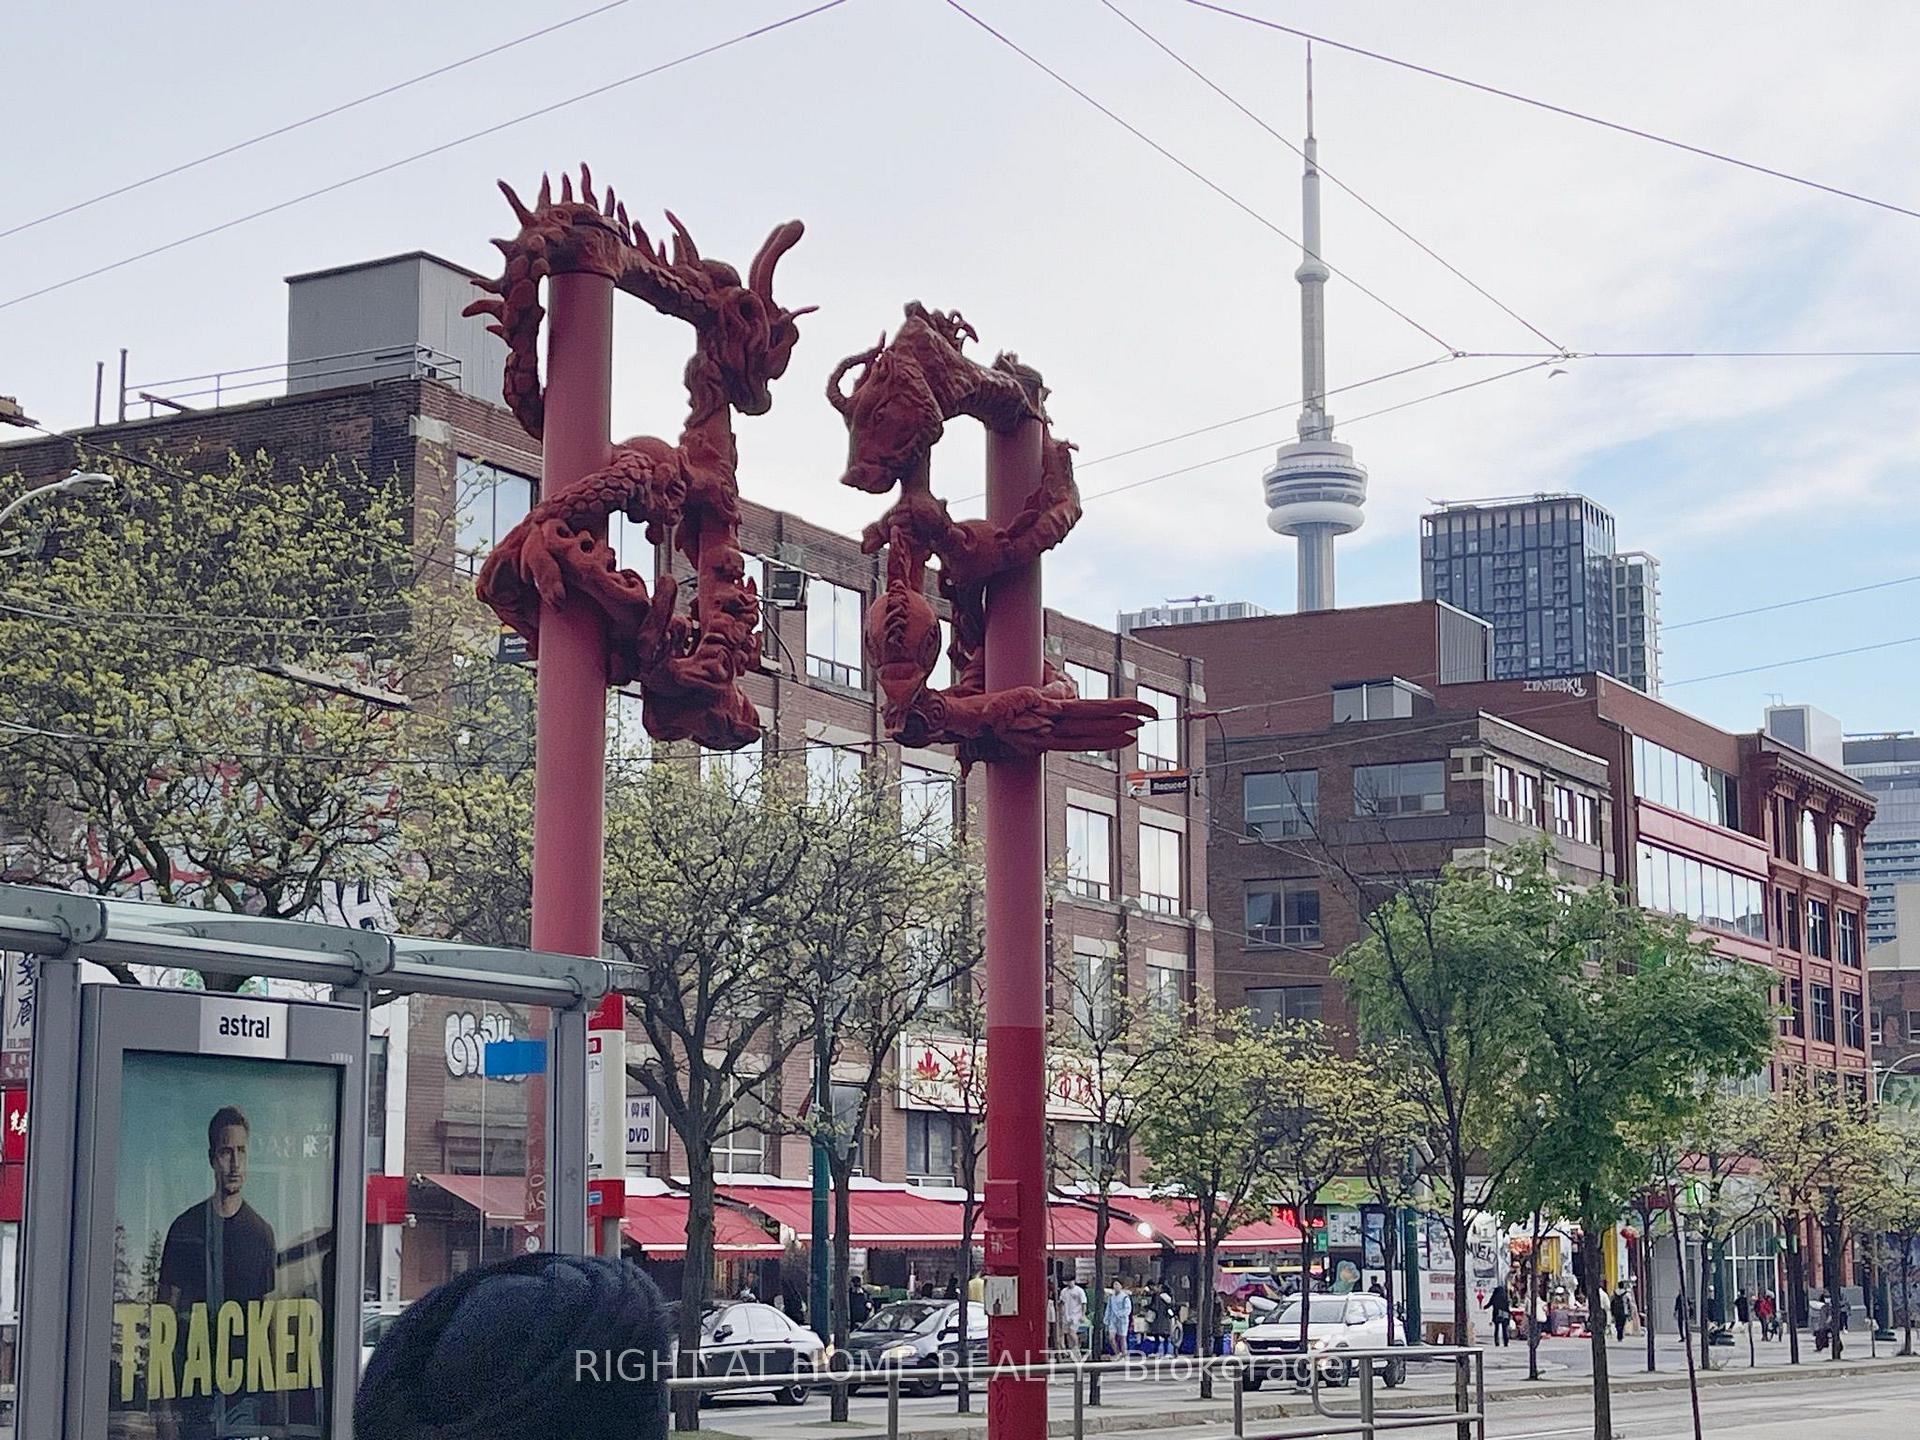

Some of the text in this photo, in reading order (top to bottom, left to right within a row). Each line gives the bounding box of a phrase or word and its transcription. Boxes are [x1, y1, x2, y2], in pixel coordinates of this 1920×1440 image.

[219, 1014, 270, 1039] astral
[629, 1127, 649, 1143] DVD
[113, 1298, 324, 1402] TRACKER
